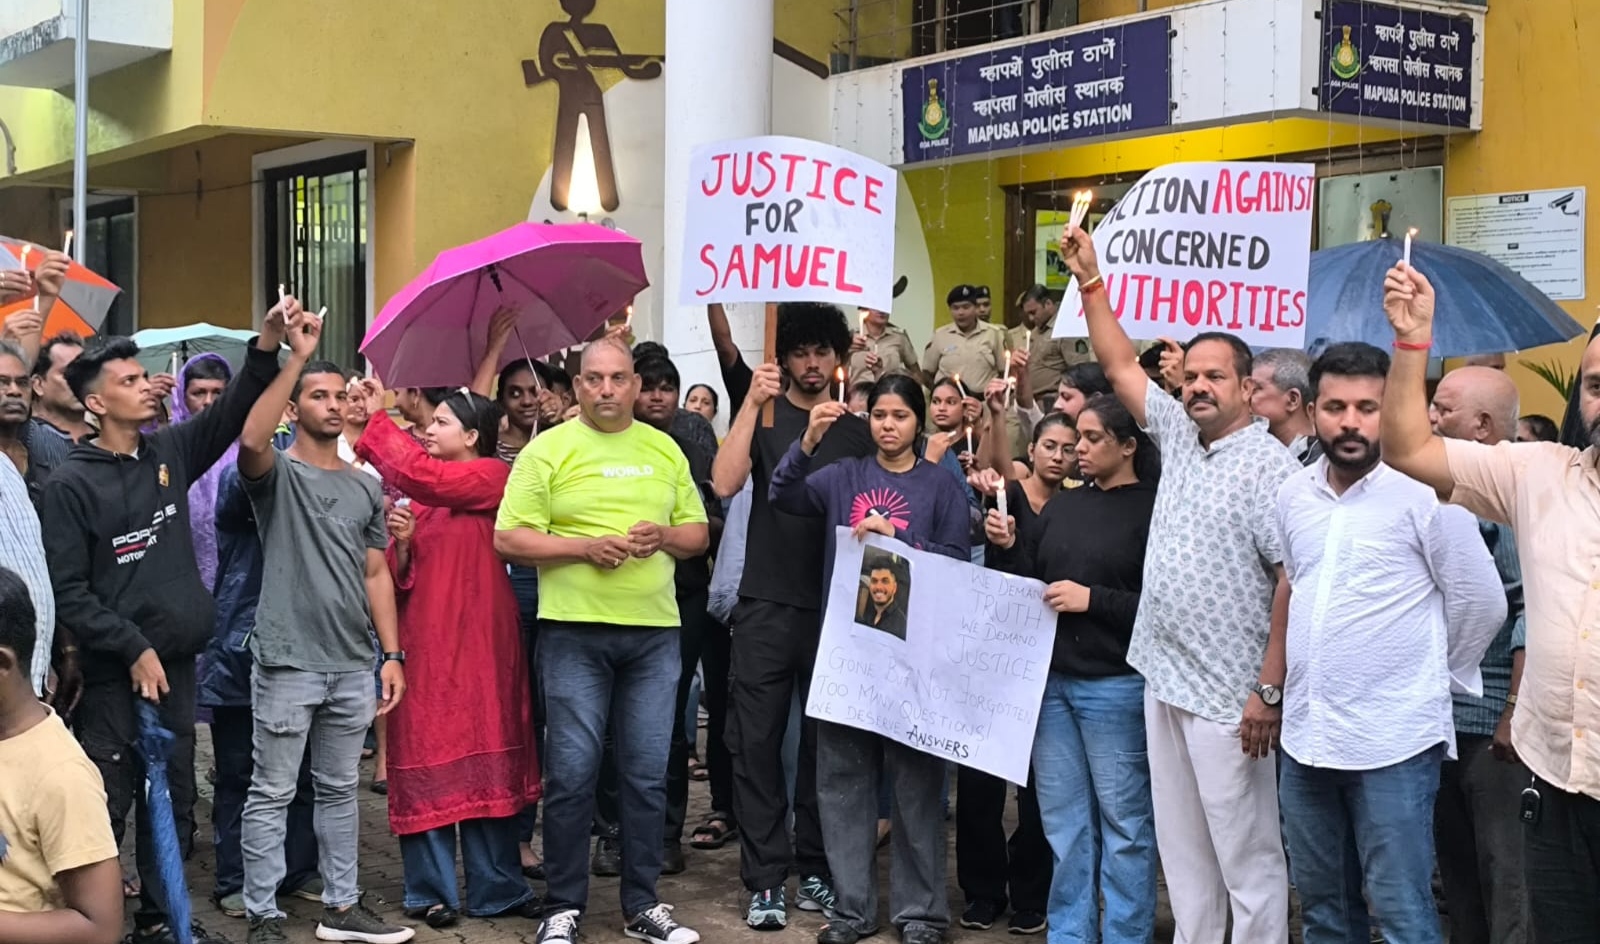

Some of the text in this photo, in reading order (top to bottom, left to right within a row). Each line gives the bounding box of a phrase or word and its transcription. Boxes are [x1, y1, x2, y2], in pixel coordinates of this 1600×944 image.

[1031, 49, 1074, 79] पुलीस
[1403, 54, 1431, 79] पोलीस
[972, 76, 1125, 117] म्हापसा पोलीस स्थानक
[1364, 84, 1467, 112] MAPUSA POLICE STATION
[968, 103, 1133, 145] MAPUSA POLICE STATION
[701, 151, 884, 215] JUSTICE
[1100, 168, 1315, 229] ACTION AGAINST
[745, 198, 804, 236] FOR
[696, 243, 863, 296] SAMUEL
[1105, 228, 1270, 270] CONCERNED
[1078, 273, 1306, 331] UTHORITIES
[602, 464, 654, 478] WORLD
[112, 503, 177, 548] PORCE
[971, 567, 1043, 600] WE DEMAN
[971, 589, 1043, 630] TRUTH
[961, 615, 1038, 648] WE DEMAND
[828, 646, 874, 678] GONE
[917, 668, 952, 702] NOT
[947, 633, 1037, 682] JUSTICE
[817, 675, 849, 697] TOO
[810, 700, 832, 715] WE
[846, 705, 901, 733] DESERVE
